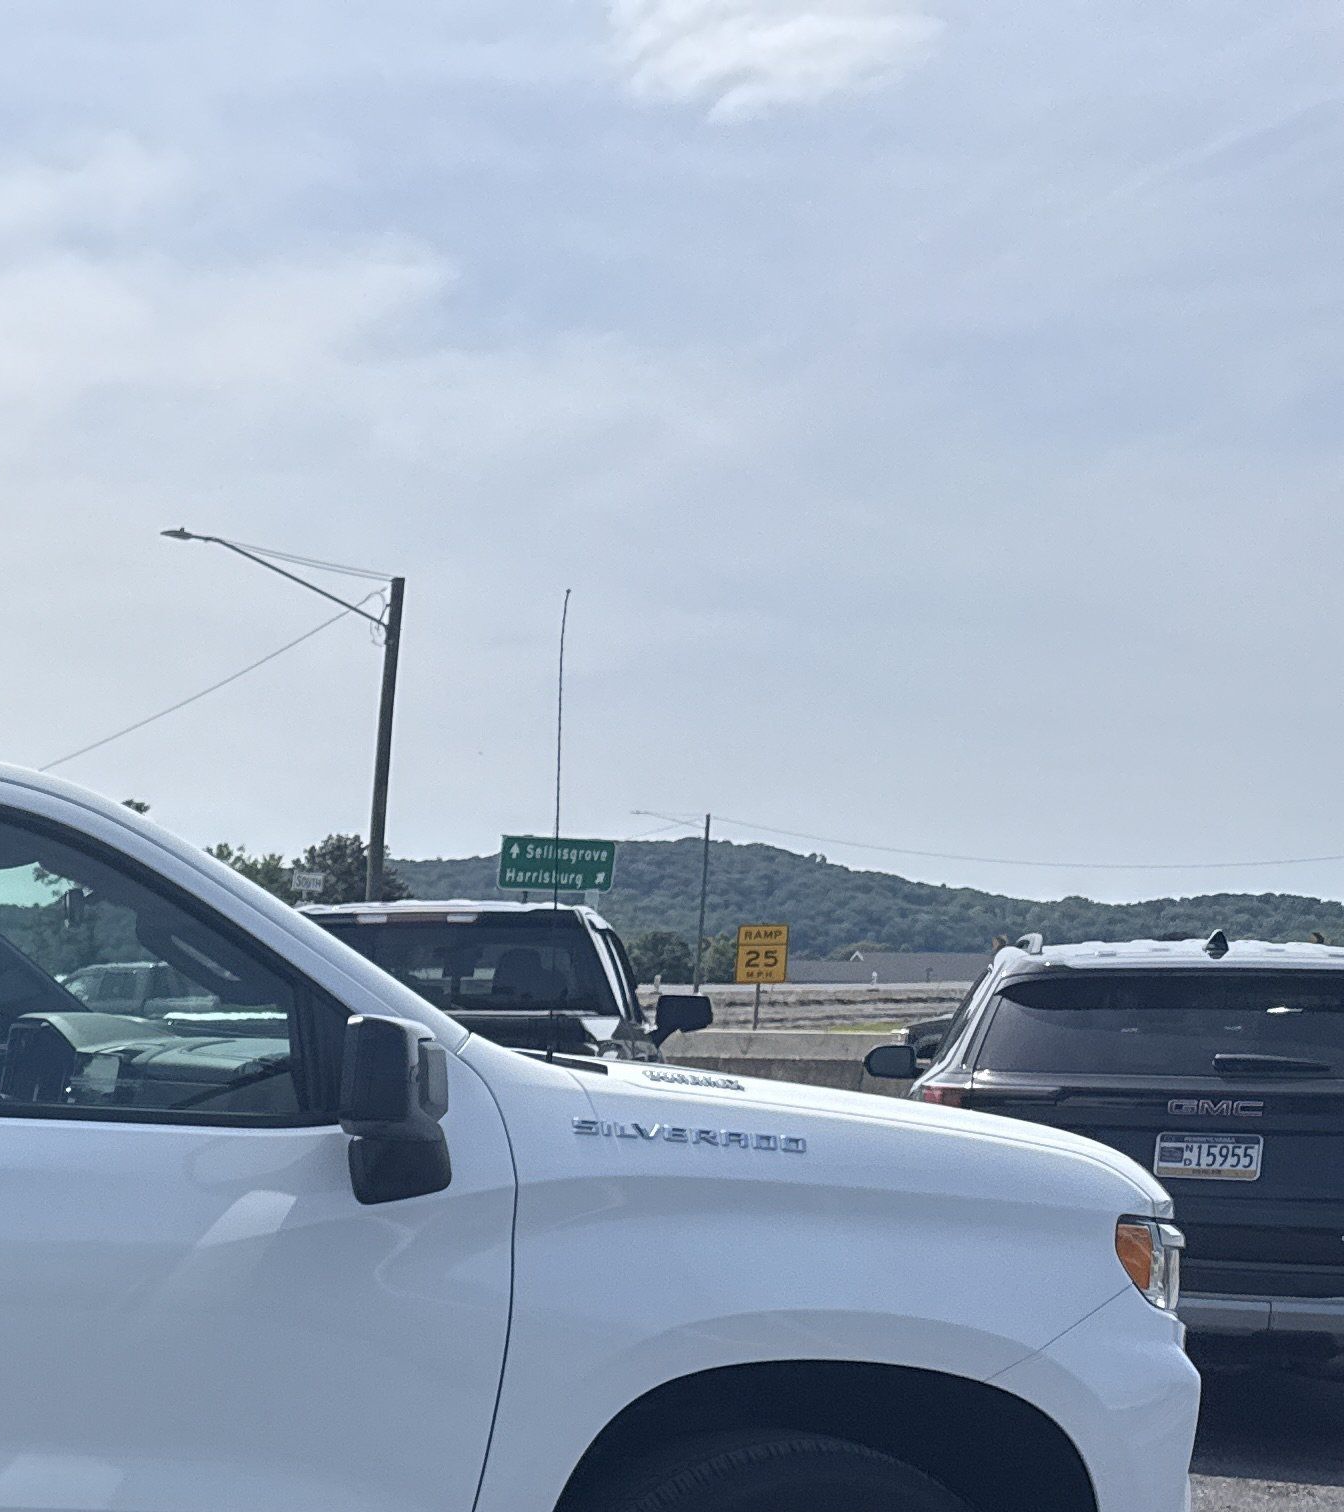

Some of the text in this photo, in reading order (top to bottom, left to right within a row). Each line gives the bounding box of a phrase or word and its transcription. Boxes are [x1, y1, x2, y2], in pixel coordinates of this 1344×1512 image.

[526, 844, 608, 864] Selinsgrove
[505, 868, 583, 889] Harrisburg
[744, 929, 782, 940] RAMP
[745, 950, 778, 968] 25
[1167, 1099, 1264, 1117] GMC
[571, 1116, 807, 1154] SILVERADO
[1195, 1144, 1255, 1168] 15955
